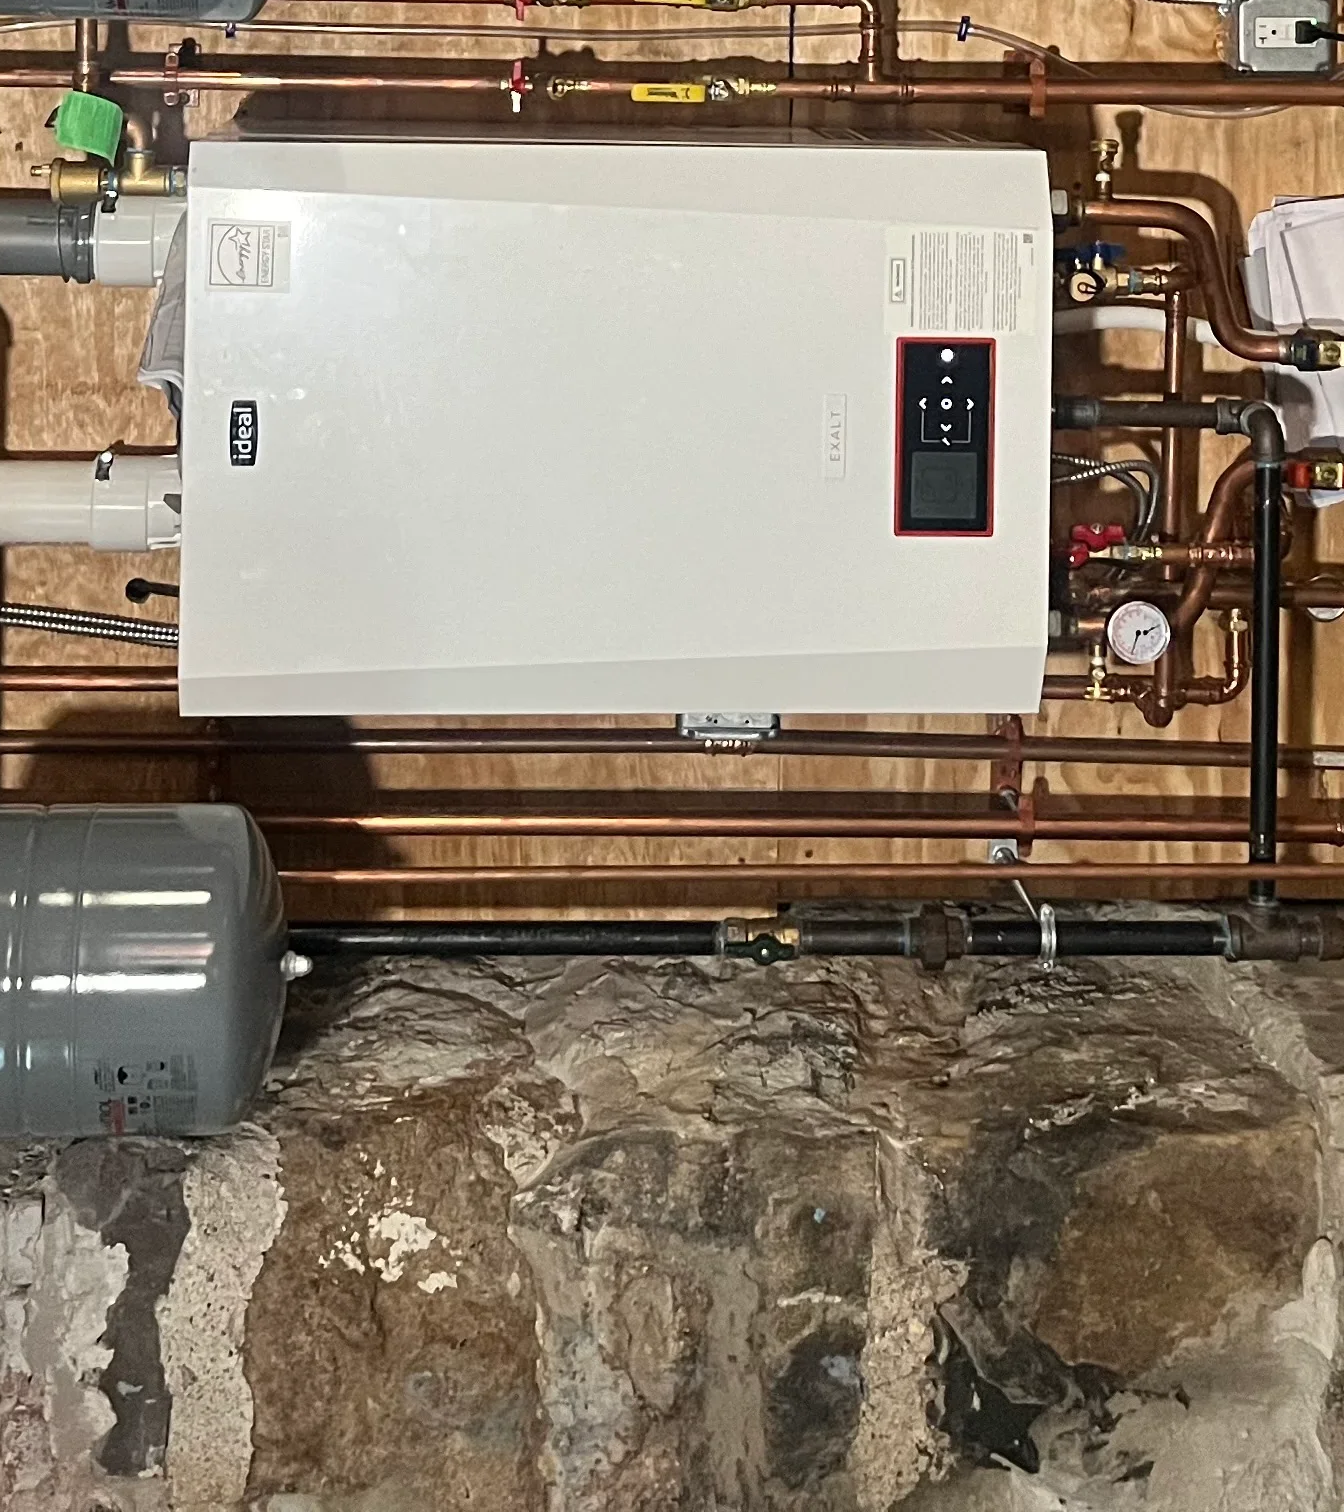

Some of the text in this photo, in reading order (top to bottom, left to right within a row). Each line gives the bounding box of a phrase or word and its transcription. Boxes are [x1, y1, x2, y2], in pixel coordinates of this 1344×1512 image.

[260, 229, 271, 284] ENERGY STAR
[233, 407, 253, 460] ideal
[829, 410, 841, 462] EXALT
